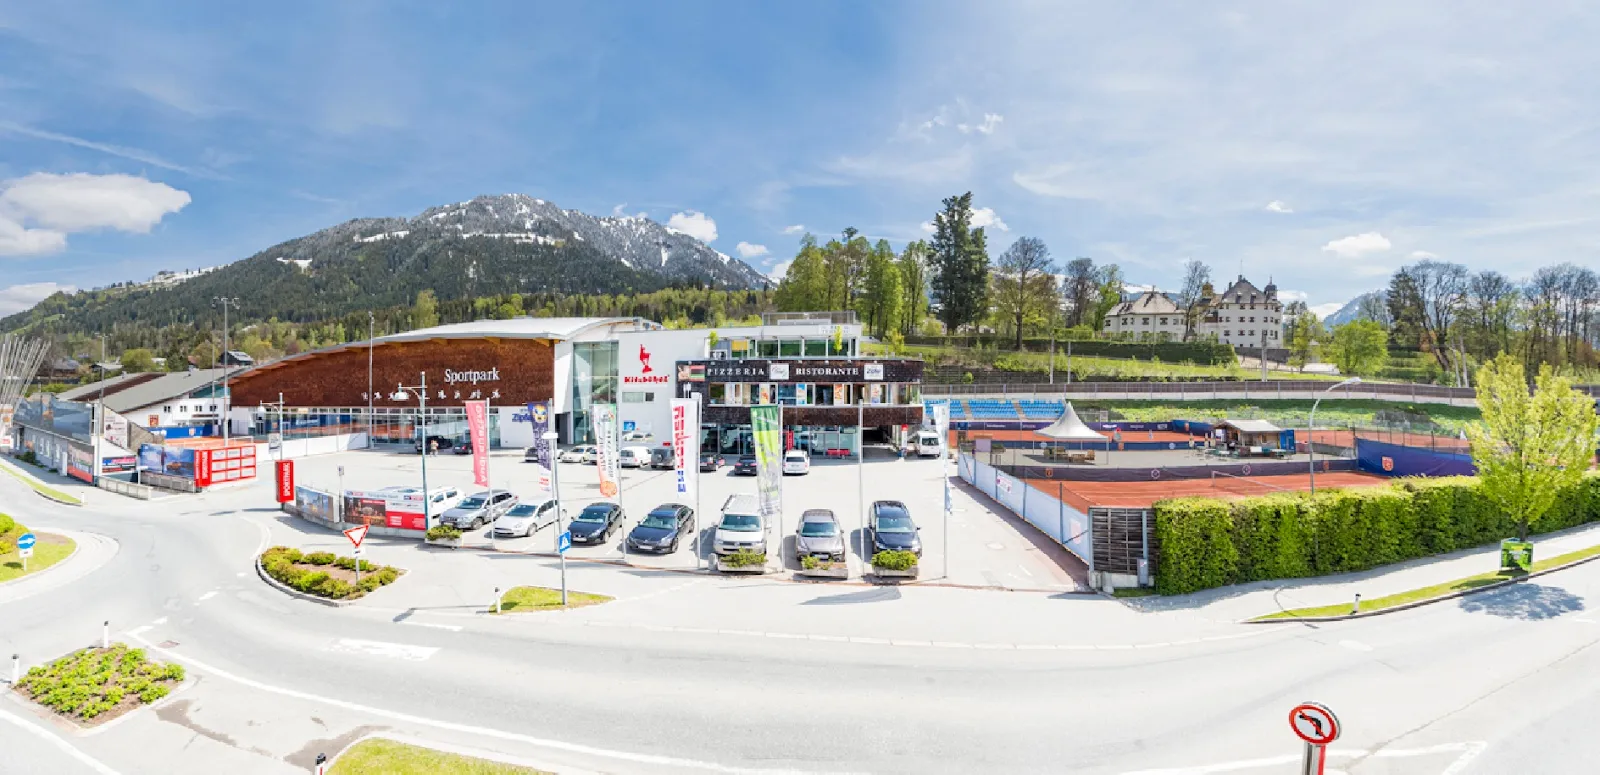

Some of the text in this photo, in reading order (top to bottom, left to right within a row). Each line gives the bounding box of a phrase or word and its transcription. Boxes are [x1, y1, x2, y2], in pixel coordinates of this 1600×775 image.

[444, 367, 500, 385] Sportpark
[707, 367, 764, 376] PIZZERIA
[795, 367, 859, 376] RISTORANTE
[282, 462, 290, 497] SPORTPARK
